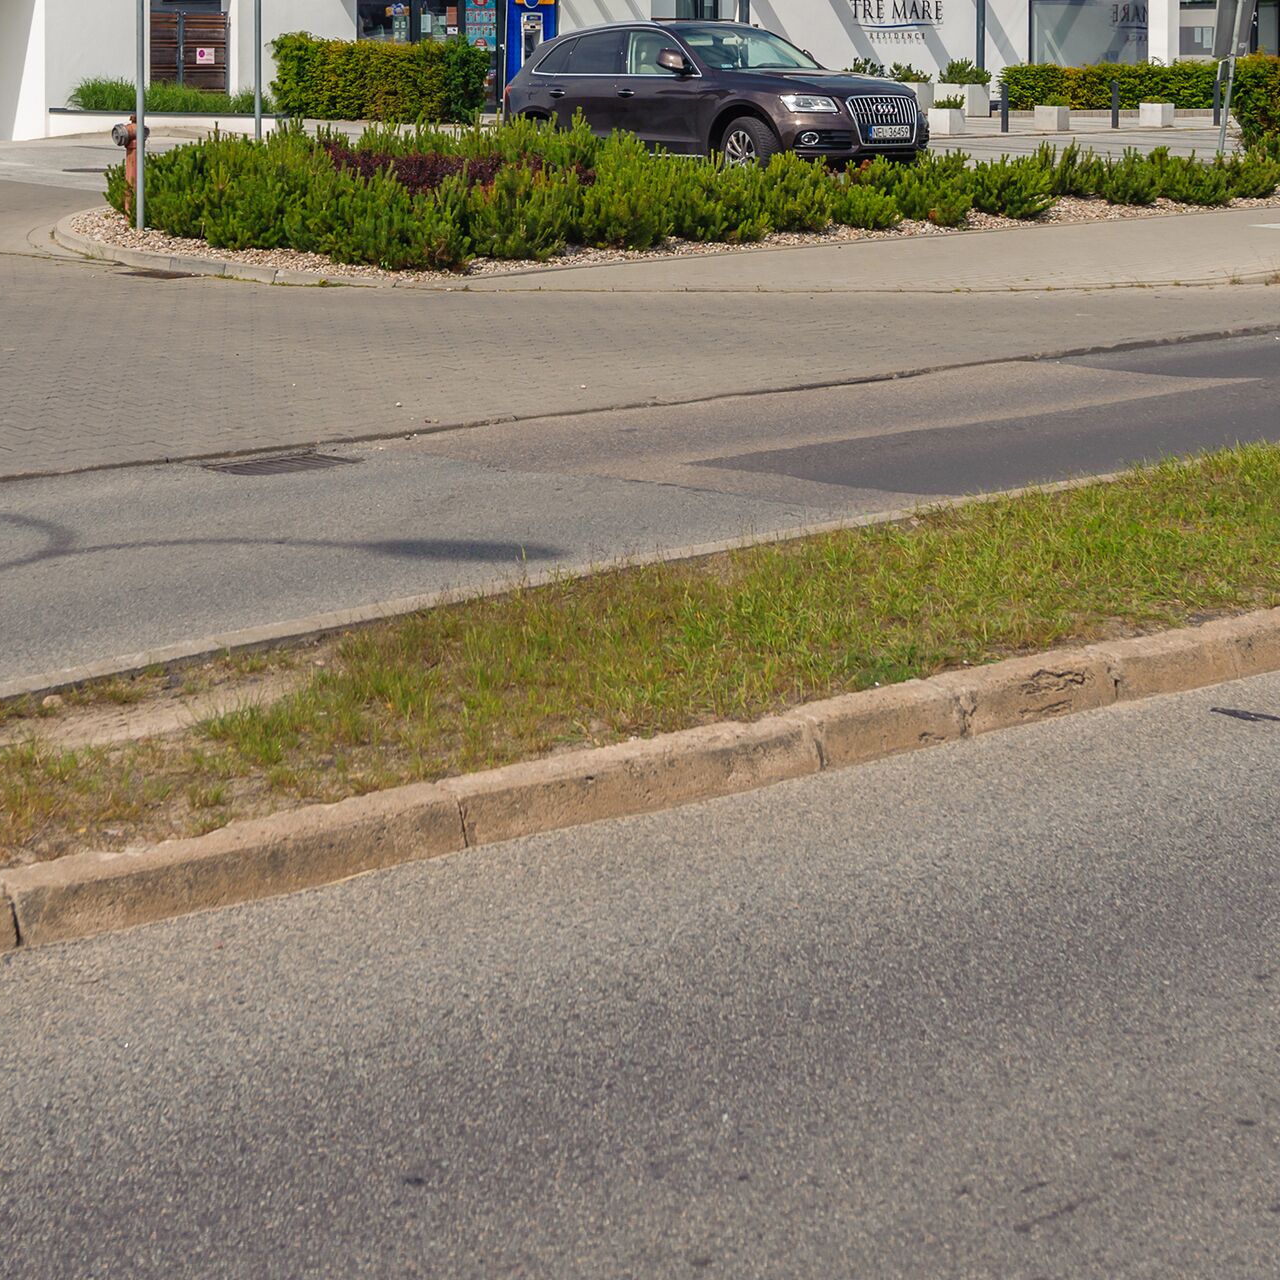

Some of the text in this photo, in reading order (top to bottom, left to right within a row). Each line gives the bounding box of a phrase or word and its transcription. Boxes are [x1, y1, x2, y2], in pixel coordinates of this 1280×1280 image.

[850, 0, 943, 20] TRE MARE
[869, 32, 926, 40] RESIDENCE
